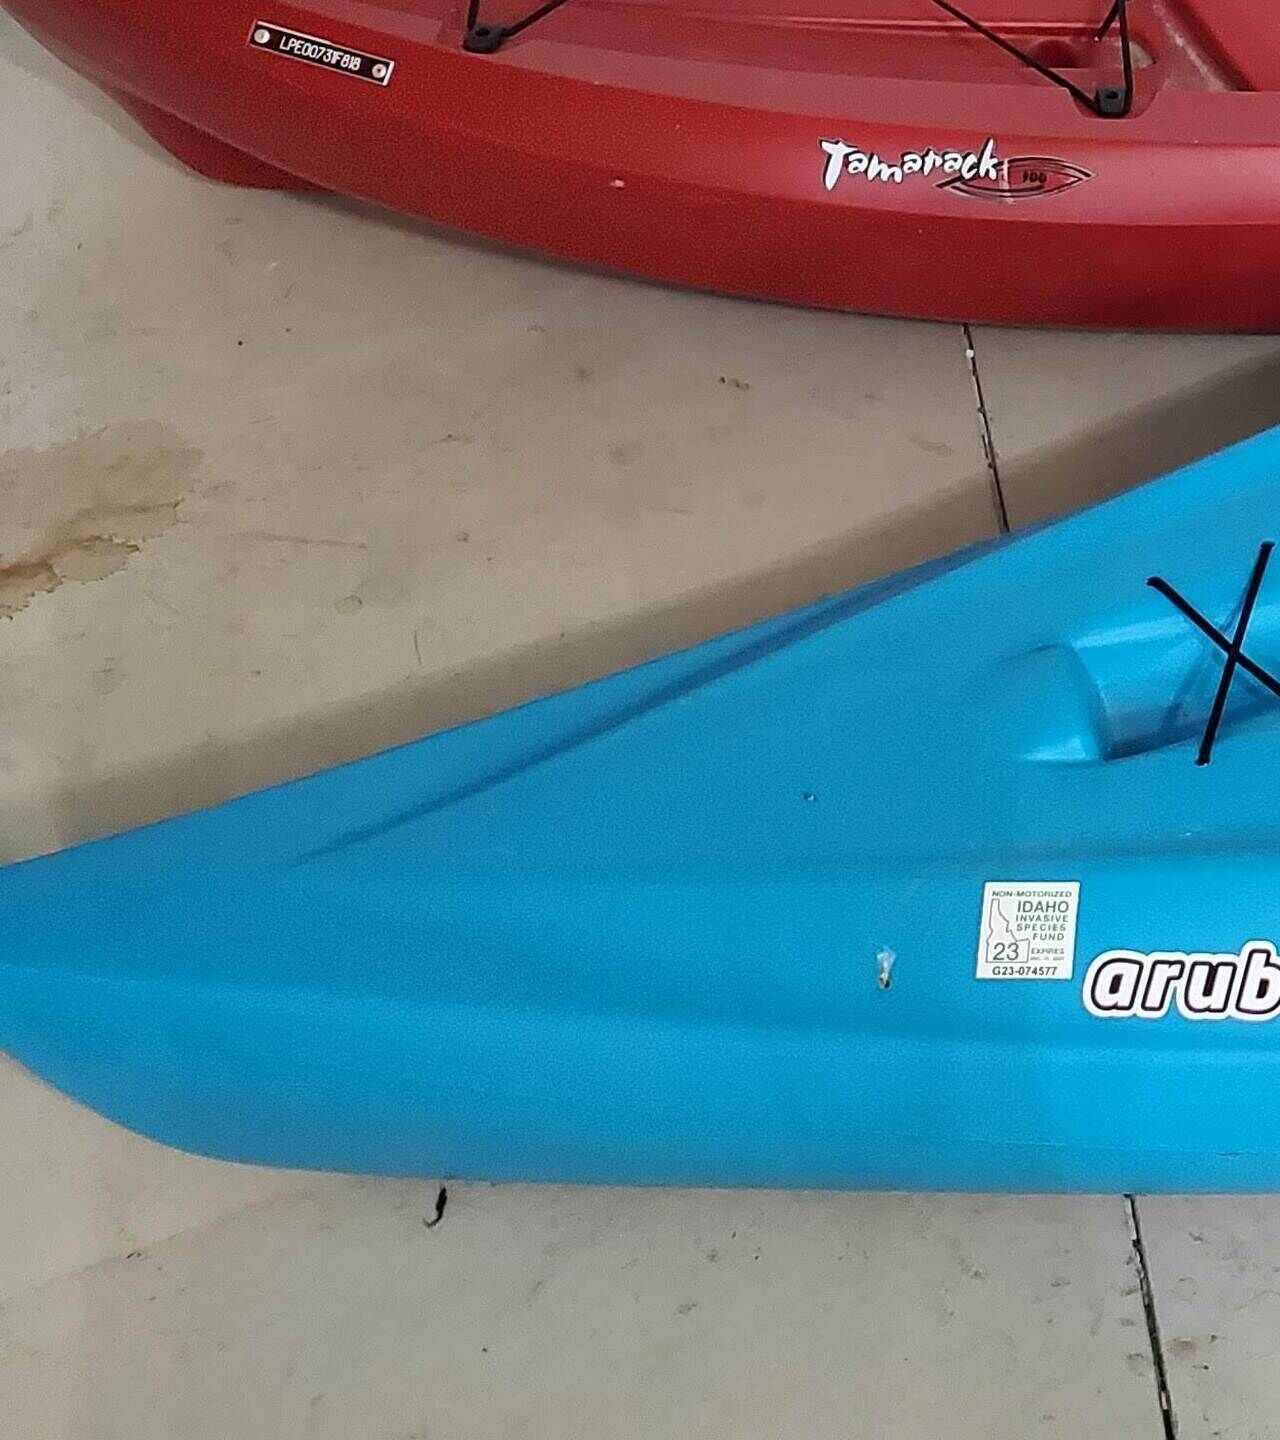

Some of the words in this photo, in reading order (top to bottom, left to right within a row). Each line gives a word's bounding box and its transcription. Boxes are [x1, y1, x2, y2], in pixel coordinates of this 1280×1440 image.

[818, 137, 999, 191] Tamarack
[991, 890, 1072, 898] NON-MOTORIZED
[1016, 900, 1070, 913] IDAHO
[1015, 914, 1069, 923] INVASIVE
[1016, 923, 1067, 932] SPECIES
[1032, 932, 1065, 941] FUND
[992, 942, 1019, 961] 23
[991, 965, 1058, 976] G23-074577
